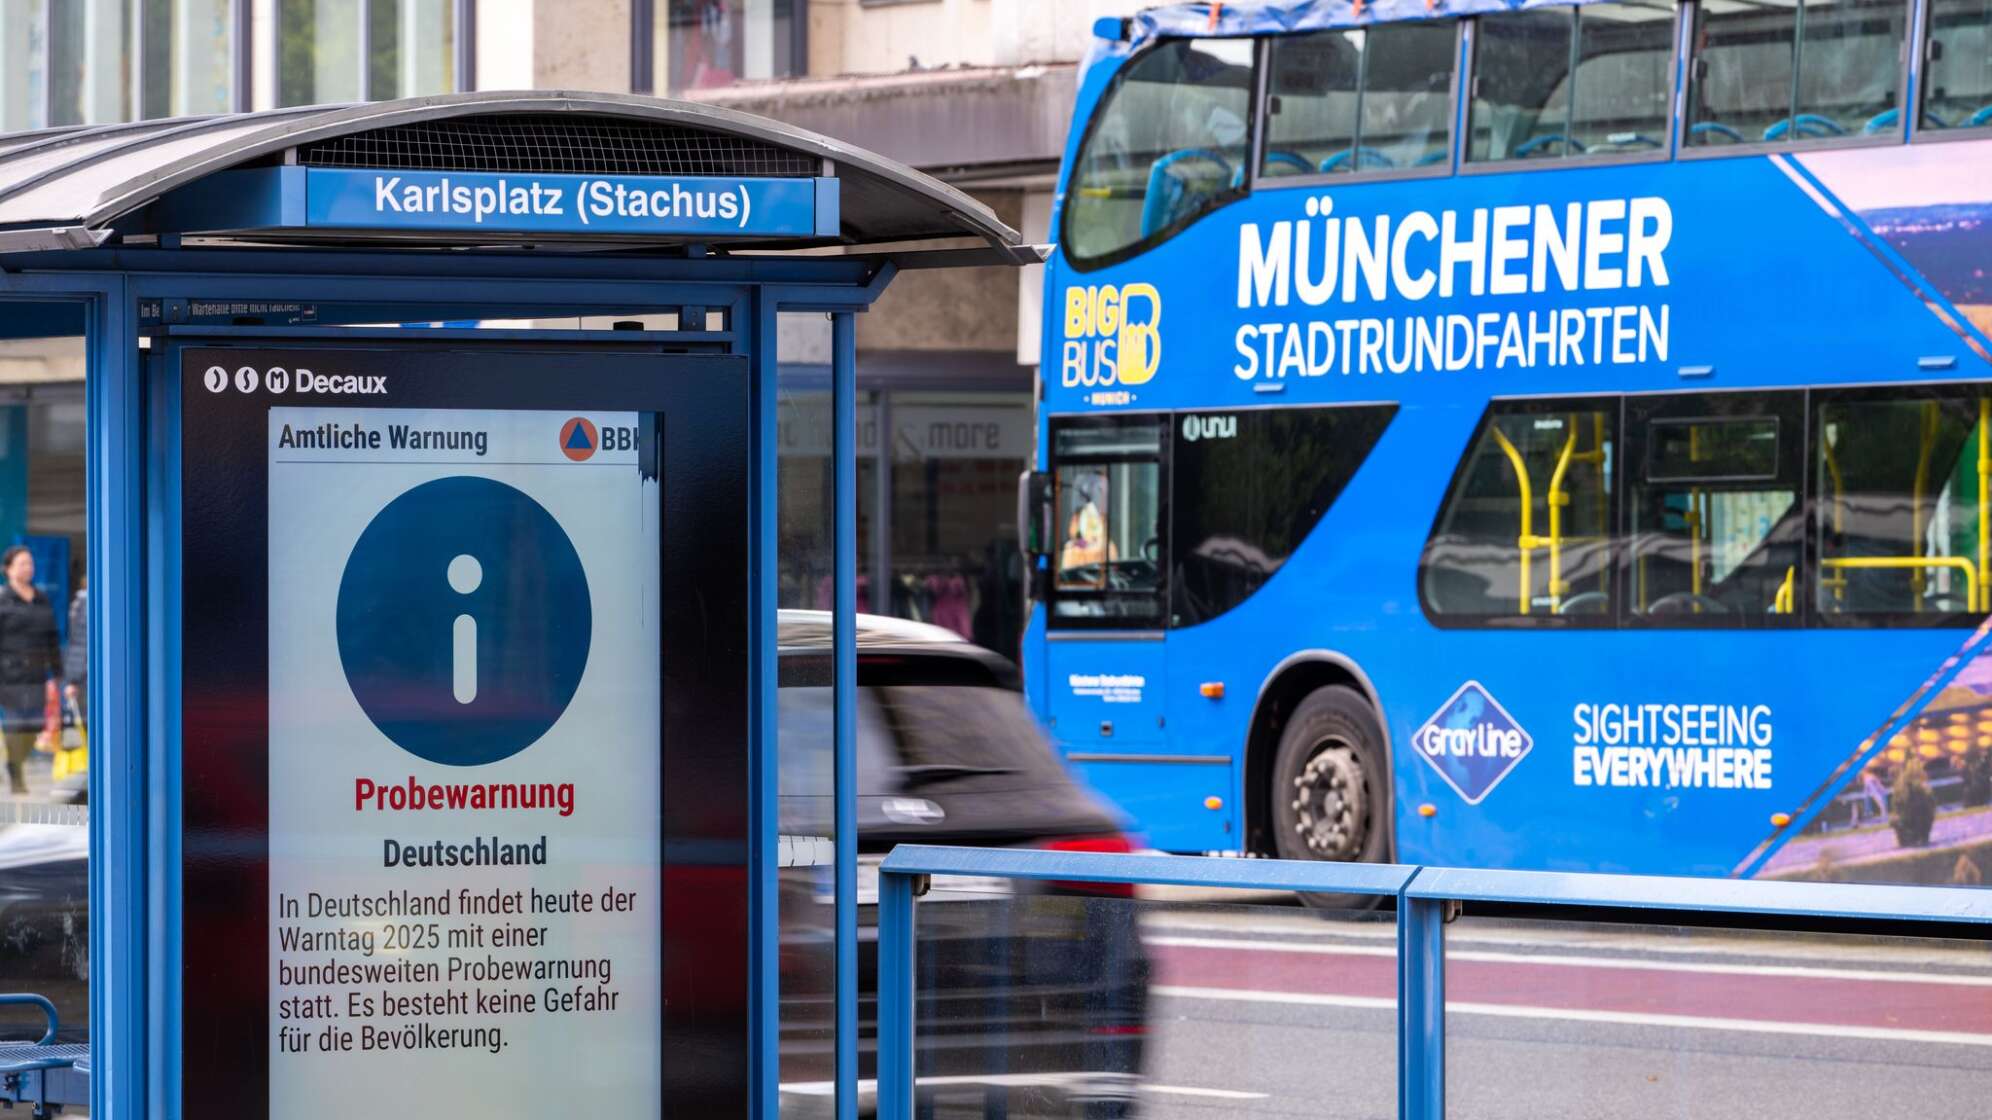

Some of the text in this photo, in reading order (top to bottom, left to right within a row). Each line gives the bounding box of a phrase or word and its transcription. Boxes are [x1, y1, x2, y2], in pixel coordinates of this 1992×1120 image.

[375, 176, 751, 229] Karlsplatz (Stachus)
[1237, 195, 1673, 309] MÜNCHENER
[1064, 284, 1120, 338] BIG
[1234, 303, 1671, 380] STADTRUNDFAHRTEN
[1062, 338, 1118, 388] BUS
[296, 368, 388, 394] Decaux
[279, 422, 488, 457] Amtliche Warnung
[928, 421, 1000, 450] more
[1573, 703, 1772, 748] SIGHTSEEING
[1573, 746, 1772, 789] EVERYWHERE
[355, 776, 575, 817] Probewarnung
[383, 835, 547, 868] Deutschland
[279, 885, 637, 919] In Deutschland findet heute der
[279, 923, 548, 957] Warntag 2025 mit einer
[279, 955, 611, 986] bundesweiten Probewarnung
[279, 985, 620, 1020] statt. Es besteht keine Gefahr
[279, 1022, 509, 1054] für die Bevölkerung.
